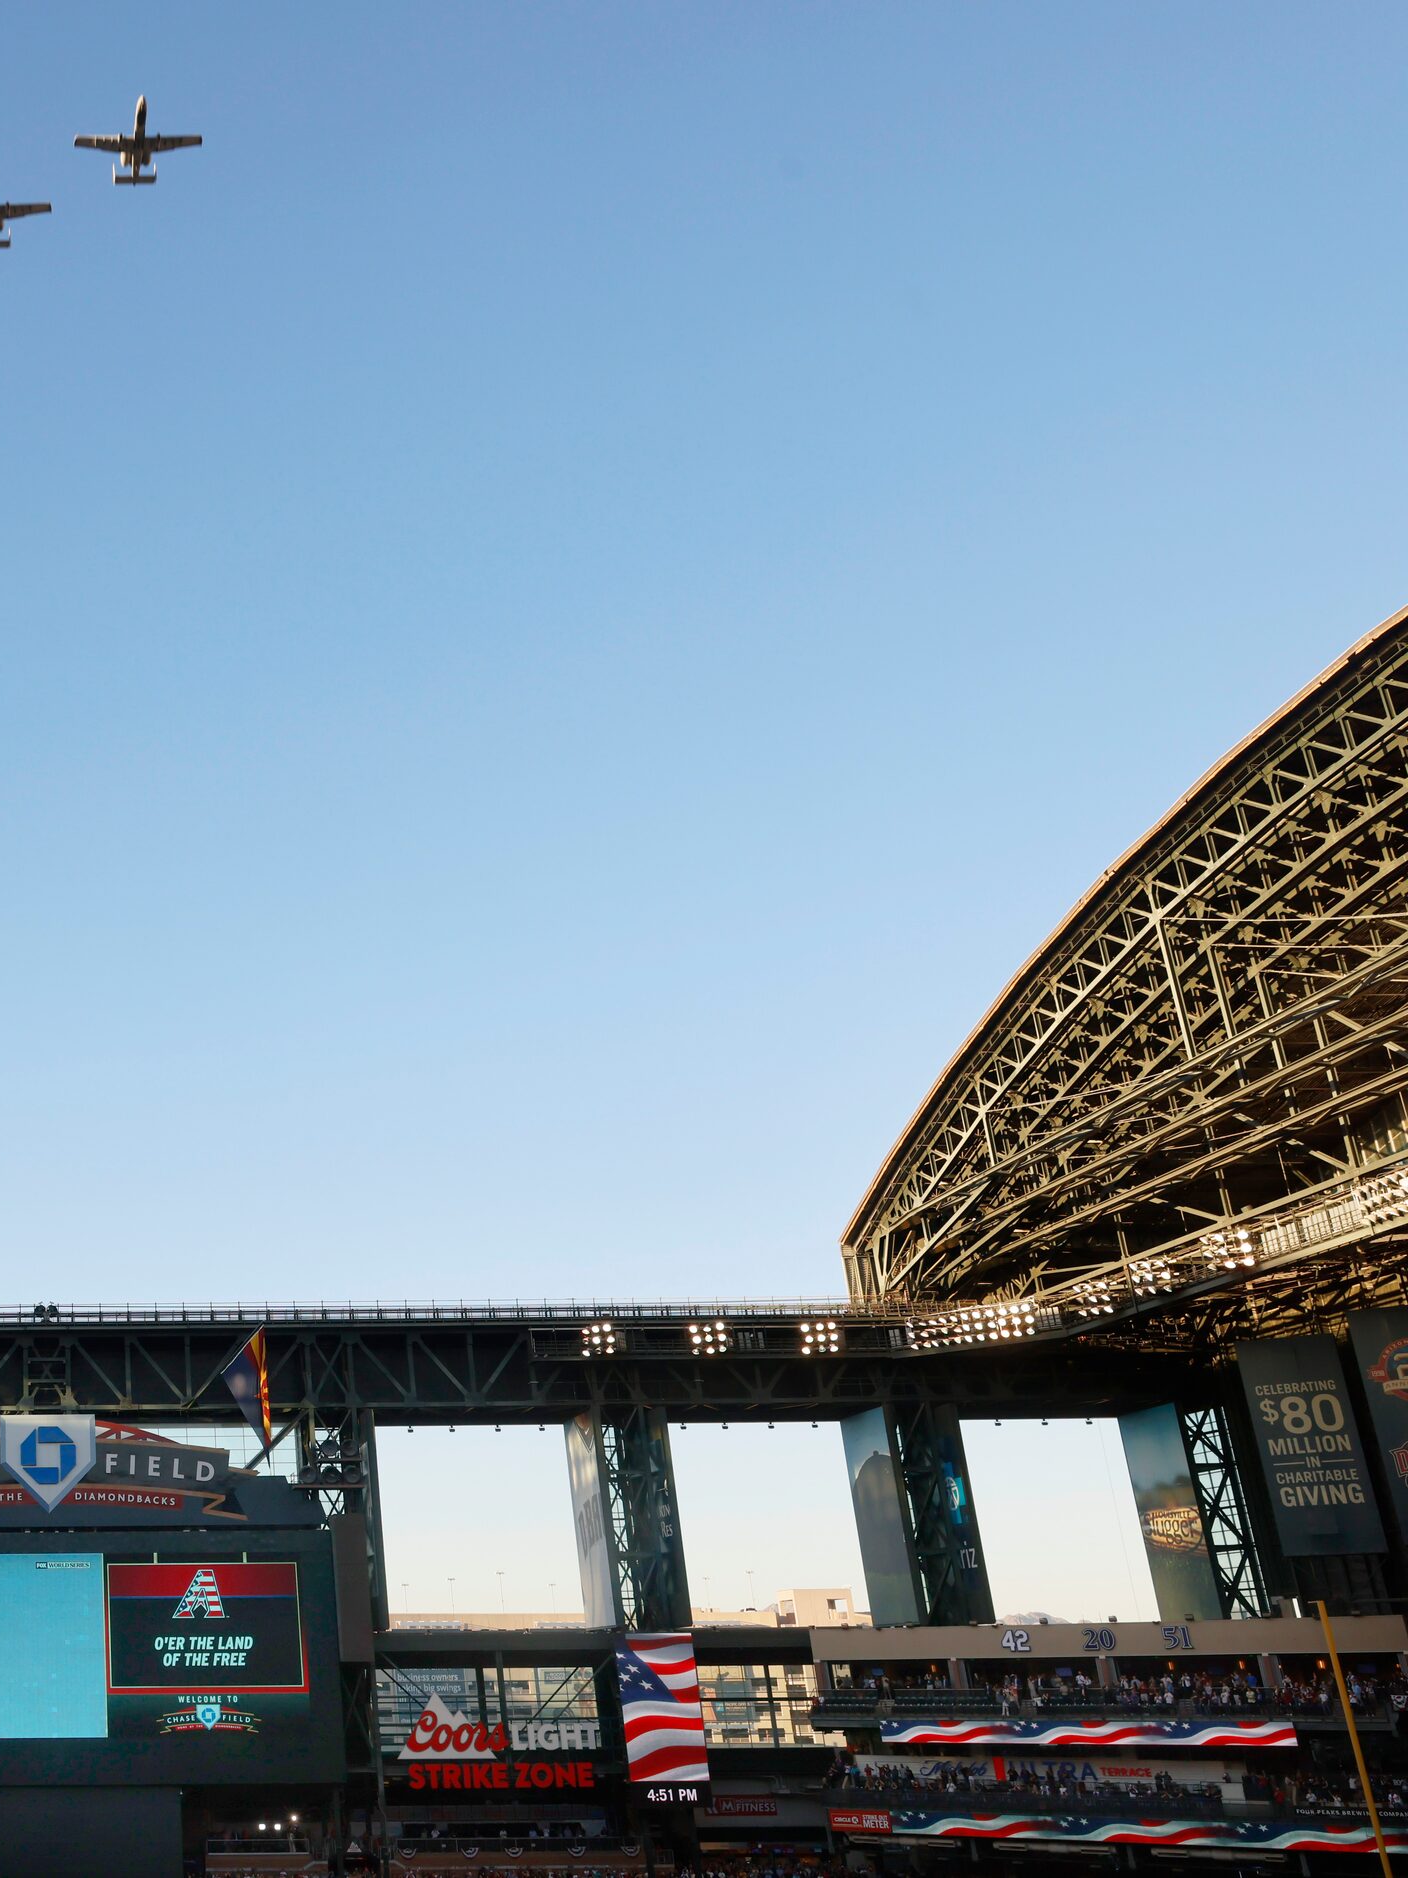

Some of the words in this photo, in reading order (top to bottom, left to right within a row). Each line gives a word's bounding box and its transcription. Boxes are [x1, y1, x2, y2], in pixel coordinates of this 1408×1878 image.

[1255, 1380, 1337, 1396] CELEBRATING
[1259, 1393, 1345, 1435] $80
[1267, 1434, 1352, 1456] MILLION
[105, 1453, 216, 1483] FIELD
[1305, 1456, 1321, 1468] IN
[1276, 1468, 1359, 1485] CHARITABLE
[74, 1492, 177, 1507] DIAMONDBACKS
[1279, 1483, 1365, 1508] GIVING
[154, 1637, 185, 1650] O'ER
[189, 1637, 214, 1650] THE
[217, 1636, 253, 1650] LAND
[1001, 1630, 1031, 1653] 42
[1082, 1627, 1116, 1651] 20
[1161, 1625, 1193, 1650] 51
[163, 1653, 180, 1667] OF
[184, 1653, 209, 1666] THE
[212, 1652, 246, 1666] FREE
[423, 1682, 435, 1694] big
[437, 1683, 461, 1693] swings
[167, 1715, 196, 1724] CHASE
[222, 1715, 251, 1723] FIELD
[407, 1711, 509, 1753] Coors
[510, 1722, 600, 1751] LIGHT
[408, 1764, 508, 1790] STRIKE
[514, 1763, 594, 1789] ZONE
[1100, 1767, 1152, 1777] TERRACE
[647, 1789, 673, 1802] 4:51
[679, 1789, 698, 1801] PM
[735, 1803, 776, 1813] FITNESS
[863, 1820, 889, 1829] METER
